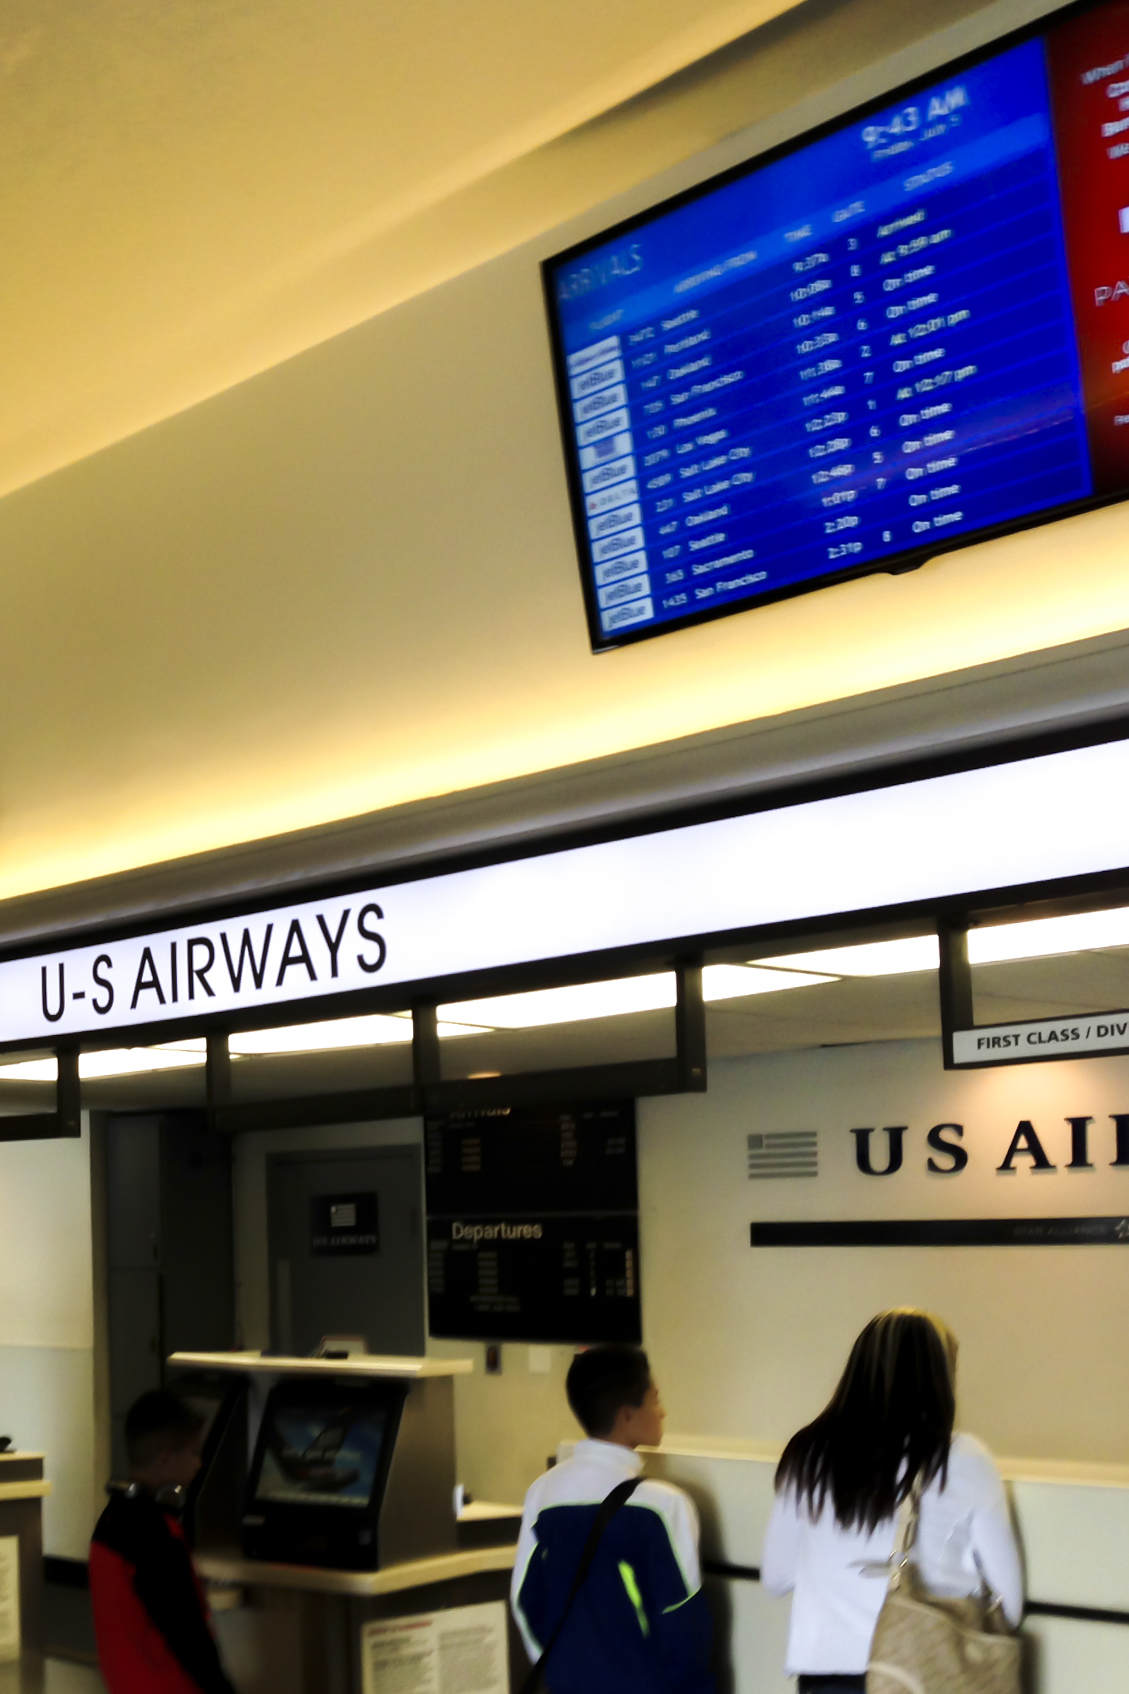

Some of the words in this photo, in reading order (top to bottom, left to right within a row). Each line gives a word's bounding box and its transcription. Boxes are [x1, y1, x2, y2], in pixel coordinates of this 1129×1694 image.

[862, 106, 919, 149] 9:43
[928, 86, 969, 120] AM
[784, 224, 812, 242] TIME
[832, 200, 866, 223] GATE
[903, 161, 954, 192] STATUS
[559, 244, 644, 299] ARRIVALS
[661, 309, 698, 331] Seattle
[877, 211, 925, 237] Arrived
[668, 357, 711, 380] Oakland
[882, 278, 903, 292] On
[903, 265, 935, 283] time
[664, 330, 711, 354] Portland
[670, 391, 691, 405] San
[690, 370, 743, 396] Francisco
[886, 305, 907, 319] On
[907, 292, 938, 311] time
[673, 407, 717, 427] Phoenix
[860, 345, 871, 358] 2
[591, 464, 628, 486] jetBlue
[676, 442, 695, 454] Las
[695, 429, 727, 445] Vegas
[863, 371, 874, 383] 7
[892, 359, 914, 373] On
[913, 348, 945, 365] time
[596, 511, 633, 535] jetBlue
[682, 488, 704, 503] Salt
[704, 479, 731, 495] Lake
[730, 472, 754, 485] City
[899, 413, 920, 427] On
[919, 402, 952, 420] time
[679, 463, 702, 479] Salt
[701, 455, 730, 471] Lake
[727, 447, 751, 460] City
[599, 535, 636, 558] jetBlue
[685, 505, 729, 527] Oakland
[902, 440, 923, 454] On
[923, 429, 955, 447] time
[602, 559, 639, 581] jetBlue
[688, 532, 726, 552] Seattle
[875, 477, 888, 490] 7
[905, 467, 925, 480] On
[925, 457, 958, 474] time
[604, 582, 642, 604] jetBlue
[691, 549, 754, 576] Sacramento
[908, 494, 928, 507] On
[929, 484, 960, 500] time
[607, 605, 644, 627] jetBlue
[662, 592, 688, 609] 1435
[694, 587, 715, 599] San
[715, 571, 768, 592] Francisco
[912, 520, 931, 533] On
[933, 511, 963, 527] time
[41, 954, 114, 1022] U-S
[130, 903, 387, 1009] AIRWAYS
[977, 1034, 1021, 1050] FIRST
[1026, 1027, 1081, 1045] CLASS
[850, 1124, 969, 1177] US
[452, 1222, 543, 1242] Departures
